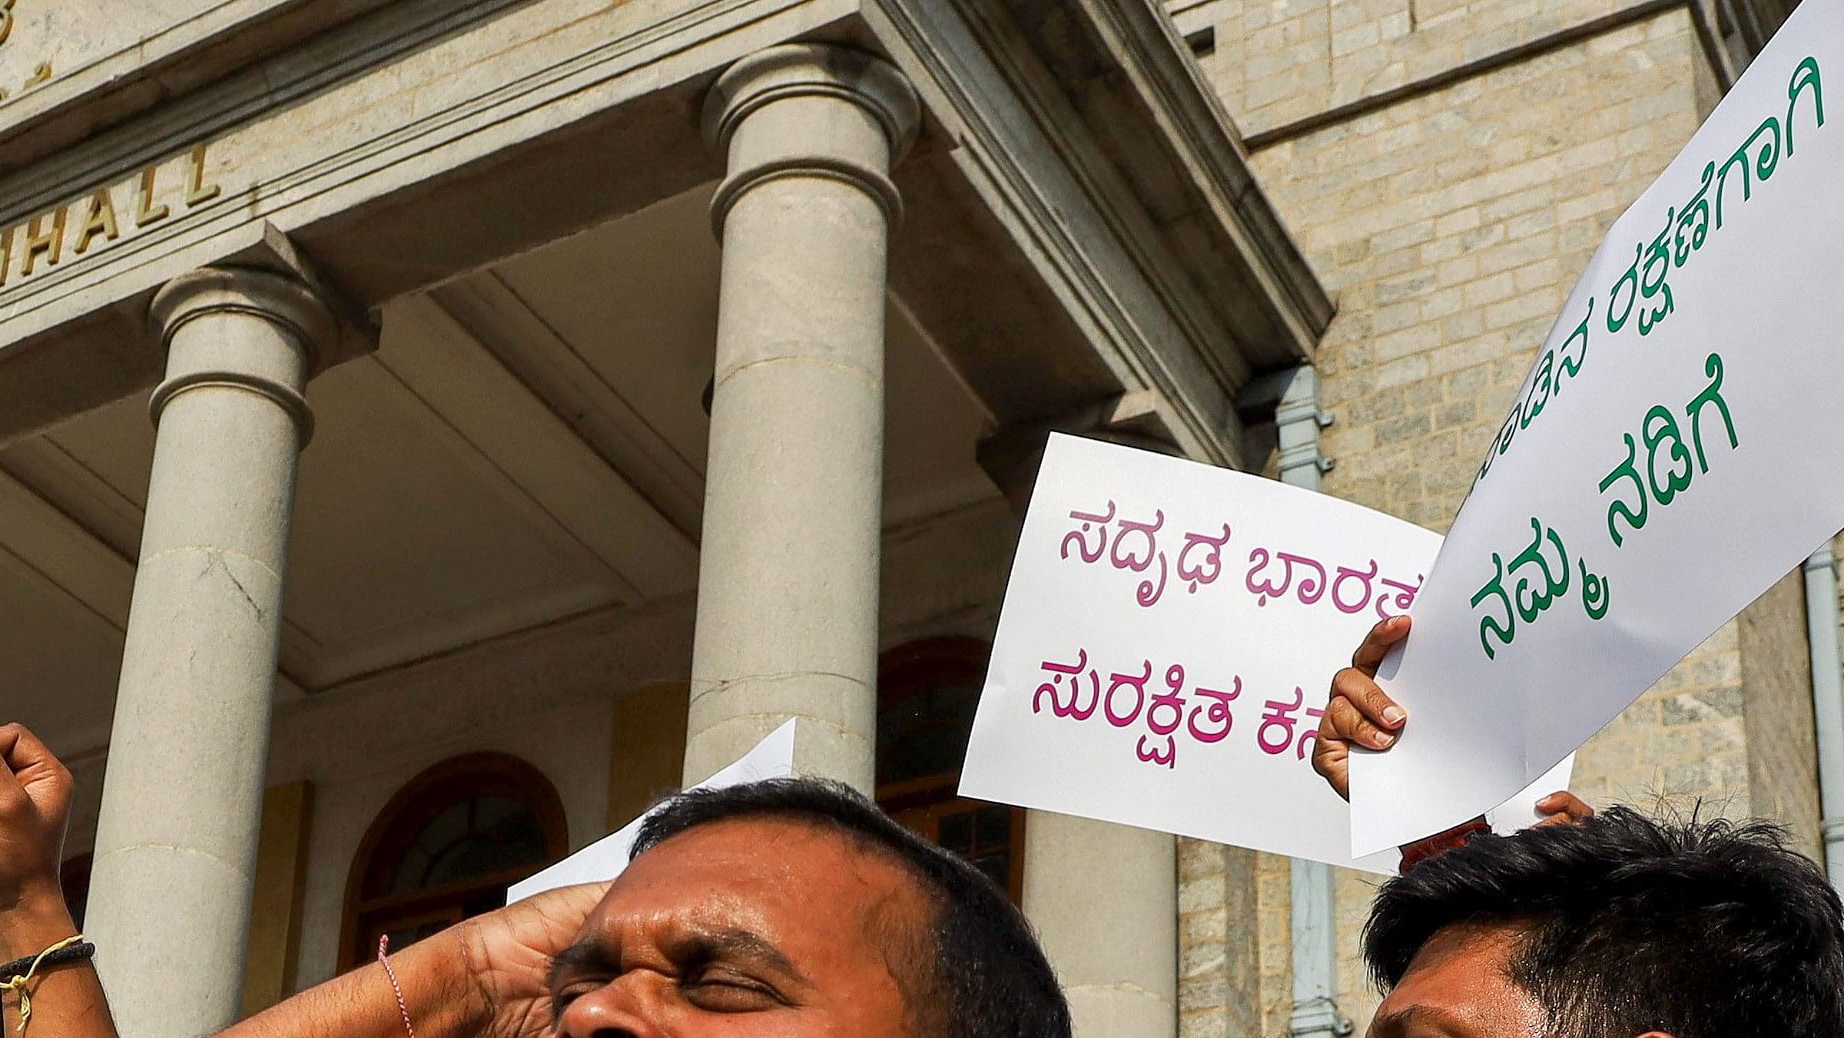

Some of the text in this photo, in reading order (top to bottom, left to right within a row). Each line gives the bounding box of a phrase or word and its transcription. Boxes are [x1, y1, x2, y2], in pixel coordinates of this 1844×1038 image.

[1606, 56, 1825, 336] ರಕ್ಷಣೆಗಾಗಿ
[1060, 499, 1231, 608] ಸದೃಢ
[1469, 352, 1739, 661] ನಮ್ಮ ನಡಿಗೆ
[1032, 648, 1242, 769] ಸುರಕ್ಷಿತ
